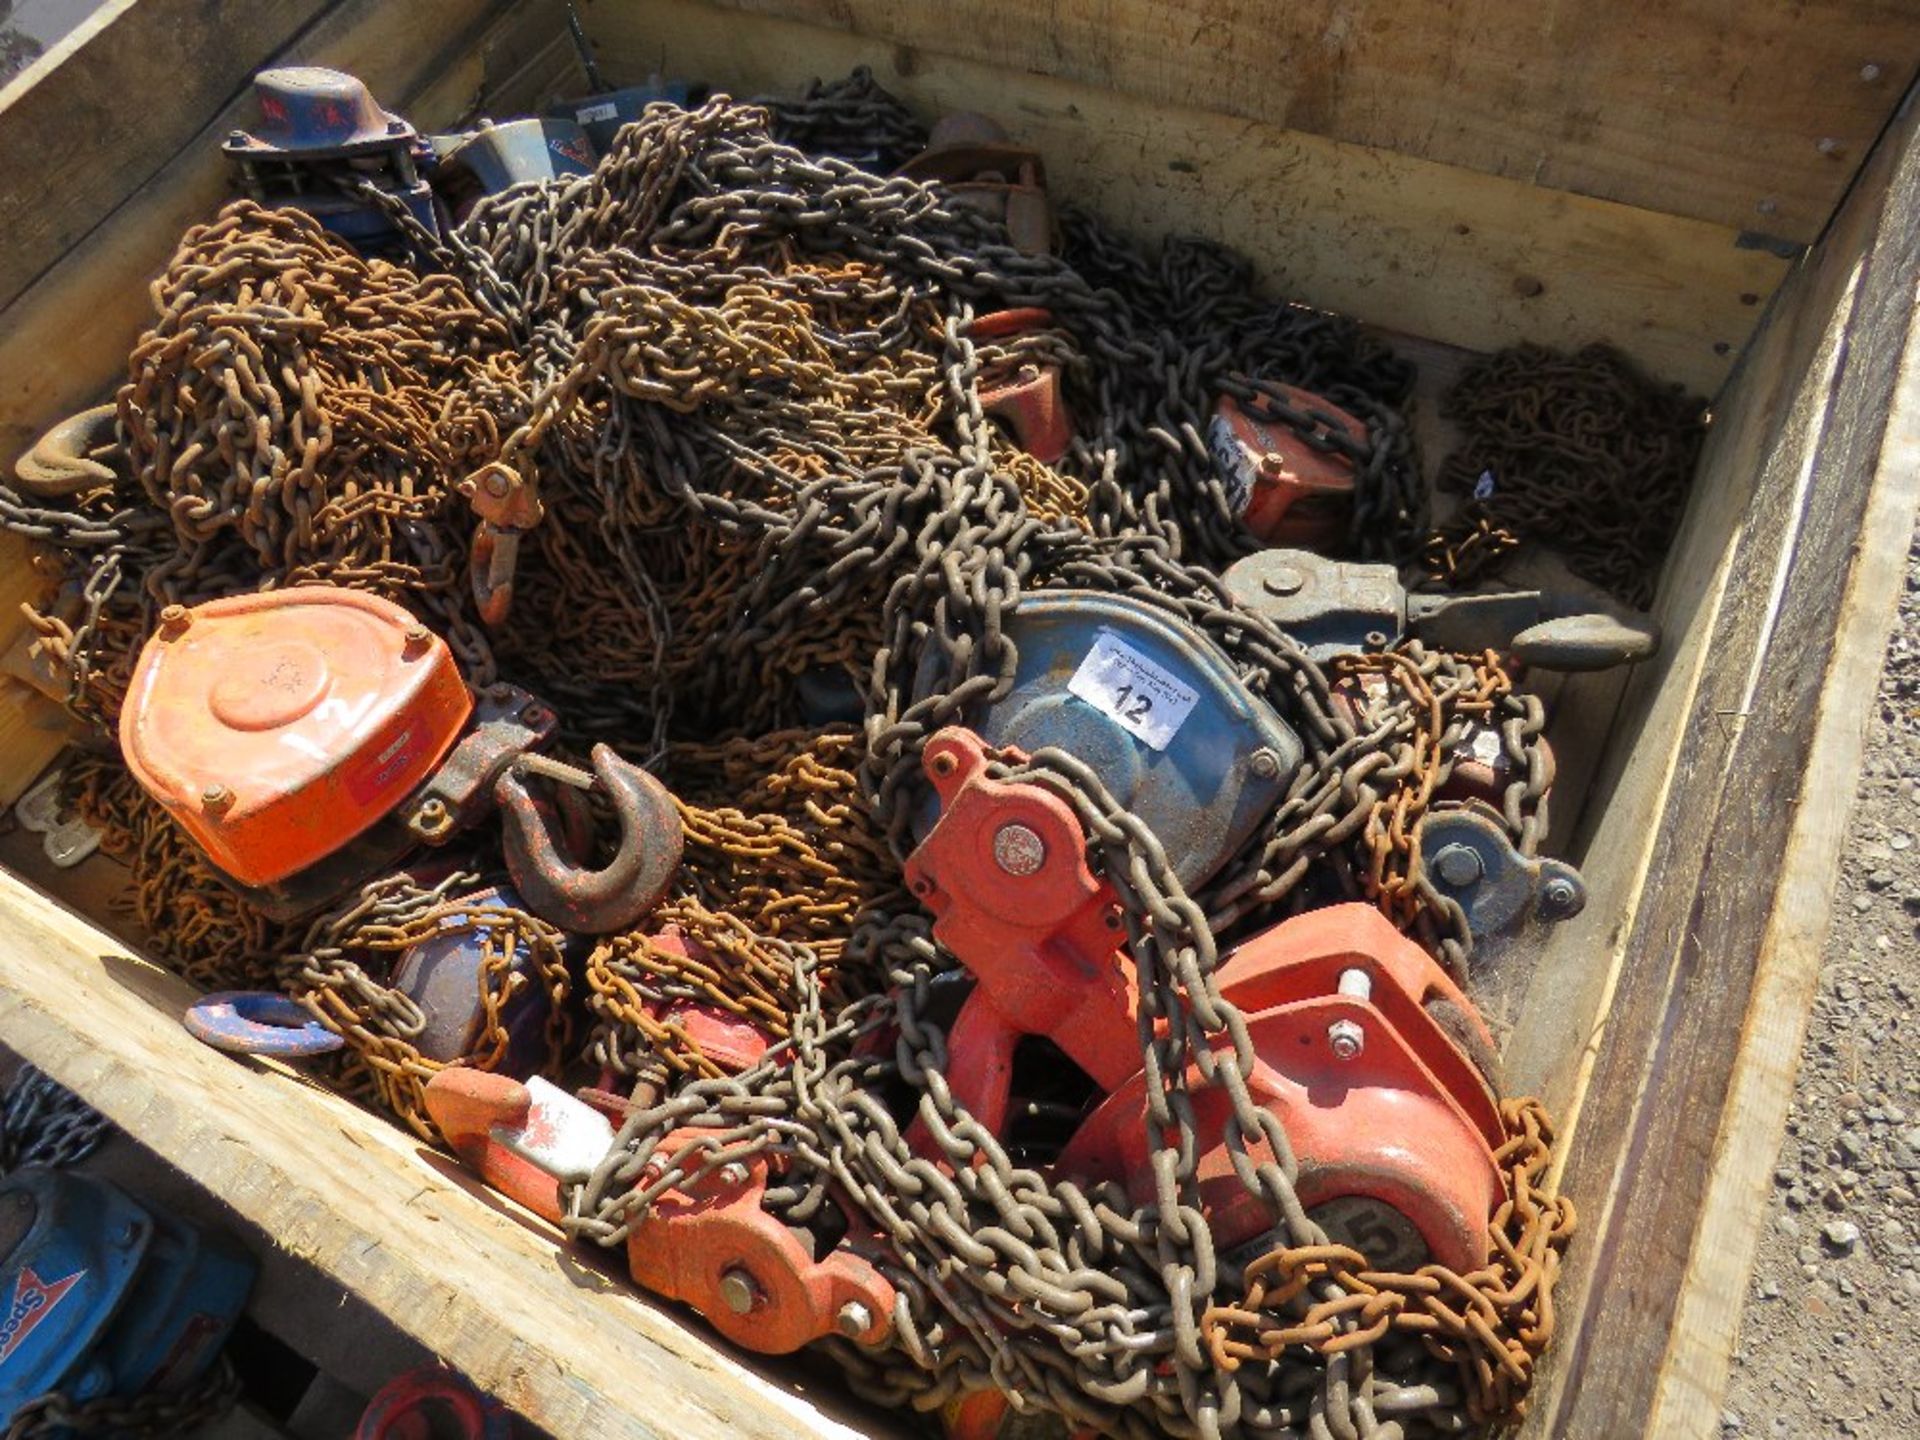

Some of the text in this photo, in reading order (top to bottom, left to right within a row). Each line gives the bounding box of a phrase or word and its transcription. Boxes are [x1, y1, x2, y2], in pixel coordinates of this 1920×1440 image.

[1114, 684, 1153, 725] 12
[1343, 1209, 1399, 1260] 5
[0, 1289, 47, 1351] Spee
